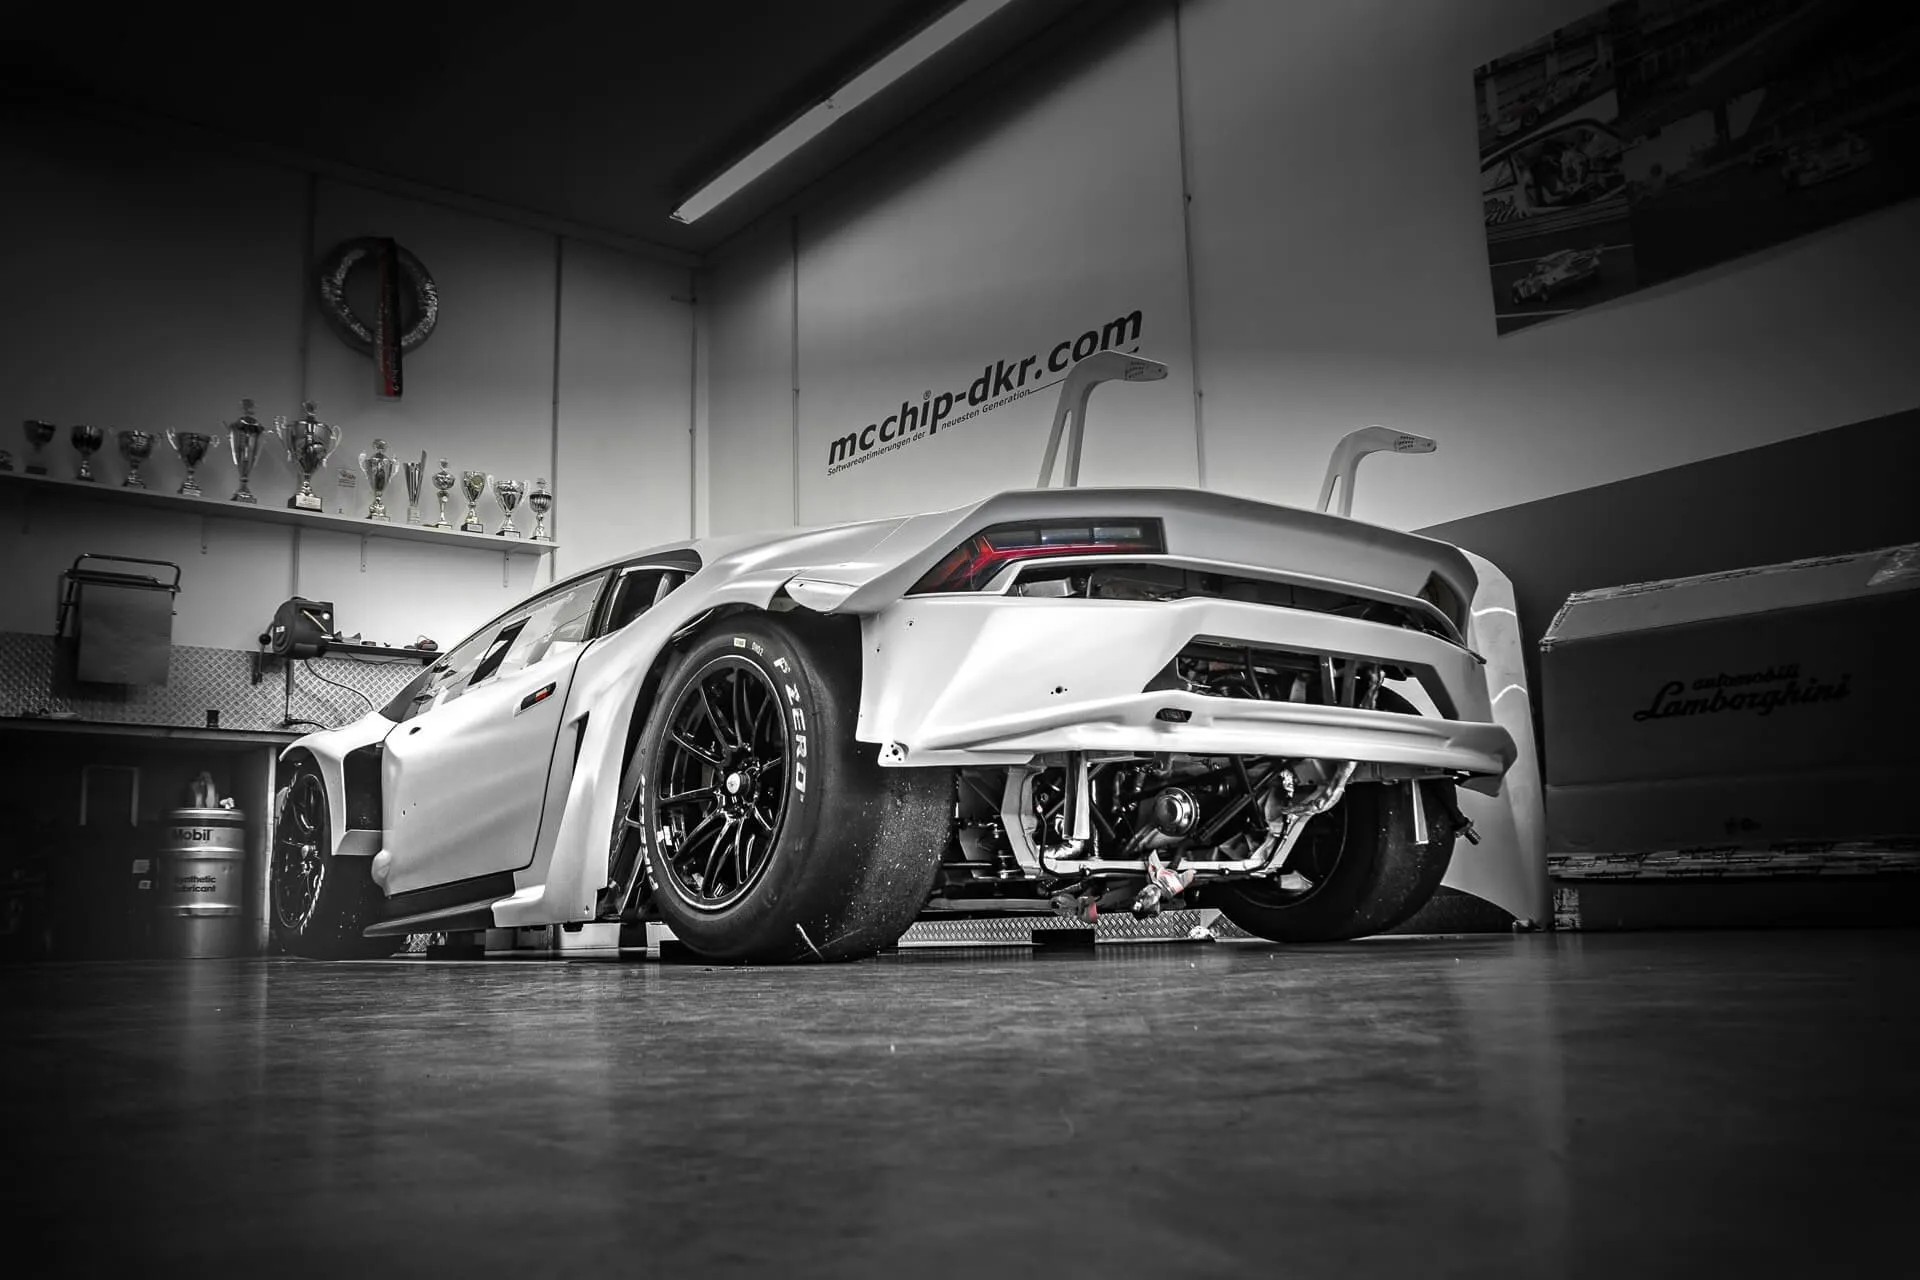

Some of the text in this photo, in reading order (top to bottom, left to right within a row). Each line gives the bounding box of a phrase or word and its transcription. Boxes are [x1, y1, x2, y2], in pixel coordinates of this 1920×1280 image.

[912, 430, 926, 443] der
[941, 408, 980, 430] neuesten
[982, 388, 1030, 413] Generation
[1633, 673, 1852, 721] Lamborghini
[785, 683, 807, 793] ZERO
